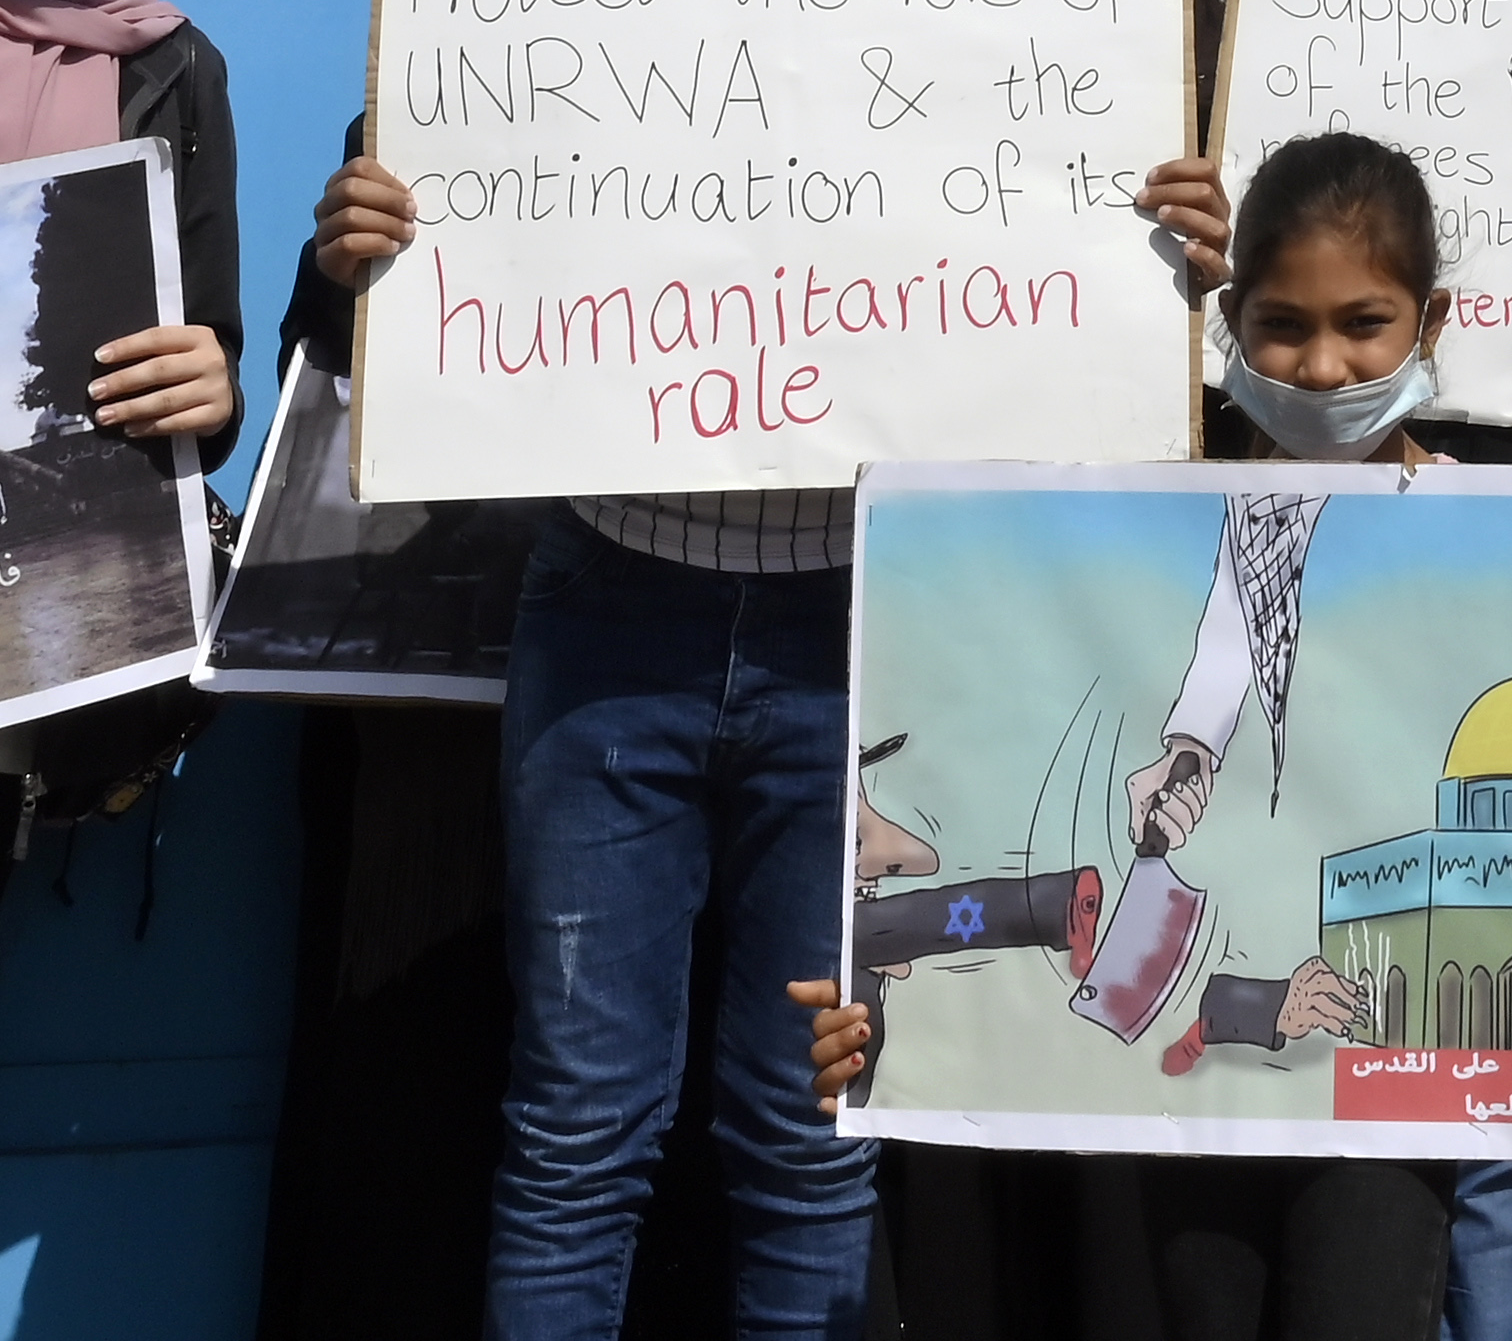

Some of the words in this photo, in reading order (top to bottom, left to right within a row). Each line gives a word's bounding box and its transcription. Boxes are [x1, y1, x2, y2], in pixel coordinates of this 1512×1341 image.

[406, 37, 768, 137] UNRWA
[863, 46, 934, 129] &
[993, 37, 1113, 116] the
[1266, 35, 1337, 118] of
[1380, 61, 1466, 119] the
[412, 153, 885, 226] continuation
[943, 139, 1021, 227] of
[1066, 151, 1138, 209] its
[434, 246, 1080, 376] humanitarian
[1351, 1051, 1436, 1077] القدس
[1451, 1052, 1500, 1079] على
